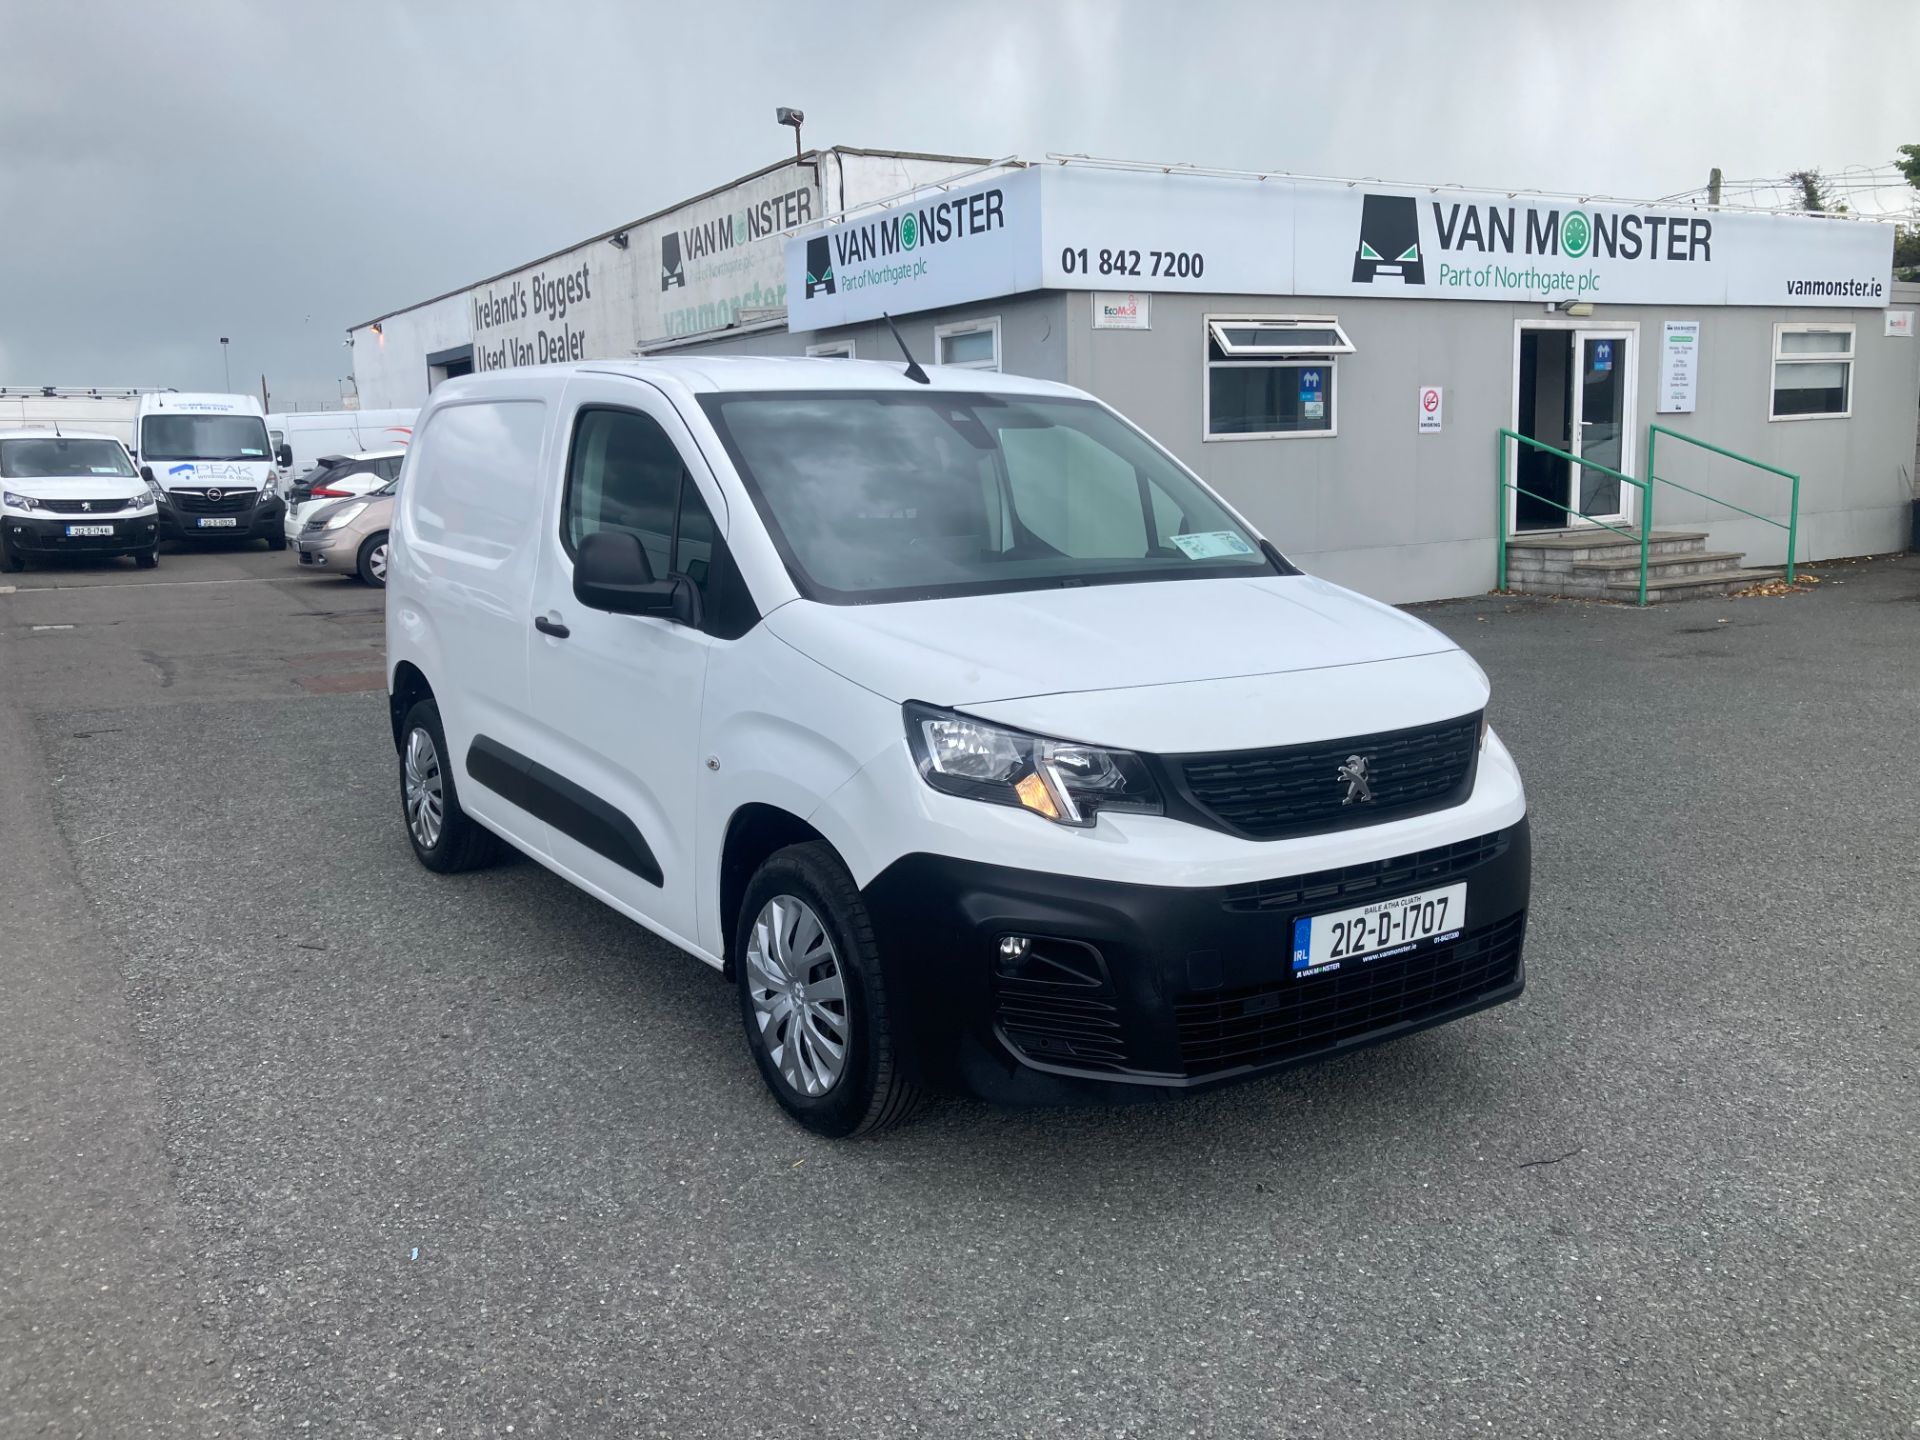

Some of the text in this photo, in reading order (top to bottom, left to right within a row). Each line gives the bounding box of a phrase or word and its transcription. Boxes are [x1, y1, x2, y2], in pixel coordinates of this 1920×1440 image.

[683, 187, 812, 261] VAN MONSTER
[835, 188, 1004, 267] VAN MONSTER
[1432, 202, 1712, 262] VAN MONSTER
[841, 257, 927, 292] Part of Northgate plc
[1061, 247, 1204, 279] 01 842 7200
[1439, 263, 1601, 295] Part of Northgate plc
[474, 262, 591, 331] Ireland's Biggest
[1786, 277, 1882, 298] vanmonster.ie
[1104, 305, 1137, 316] EcoMod
[478, 322, 585, 373] Used Van Dealer
[195, 464, 254, 477] PEAK
[1364, 903, 1382, 915] BAILE
[1330, 896, 1449, 958] 212-D-1707
[1293, 949, 1308, 962] IRL
[1362, 943, 1417, 963] www.vanmonster.ie
[1302, 966, 1314, 977] VAN
